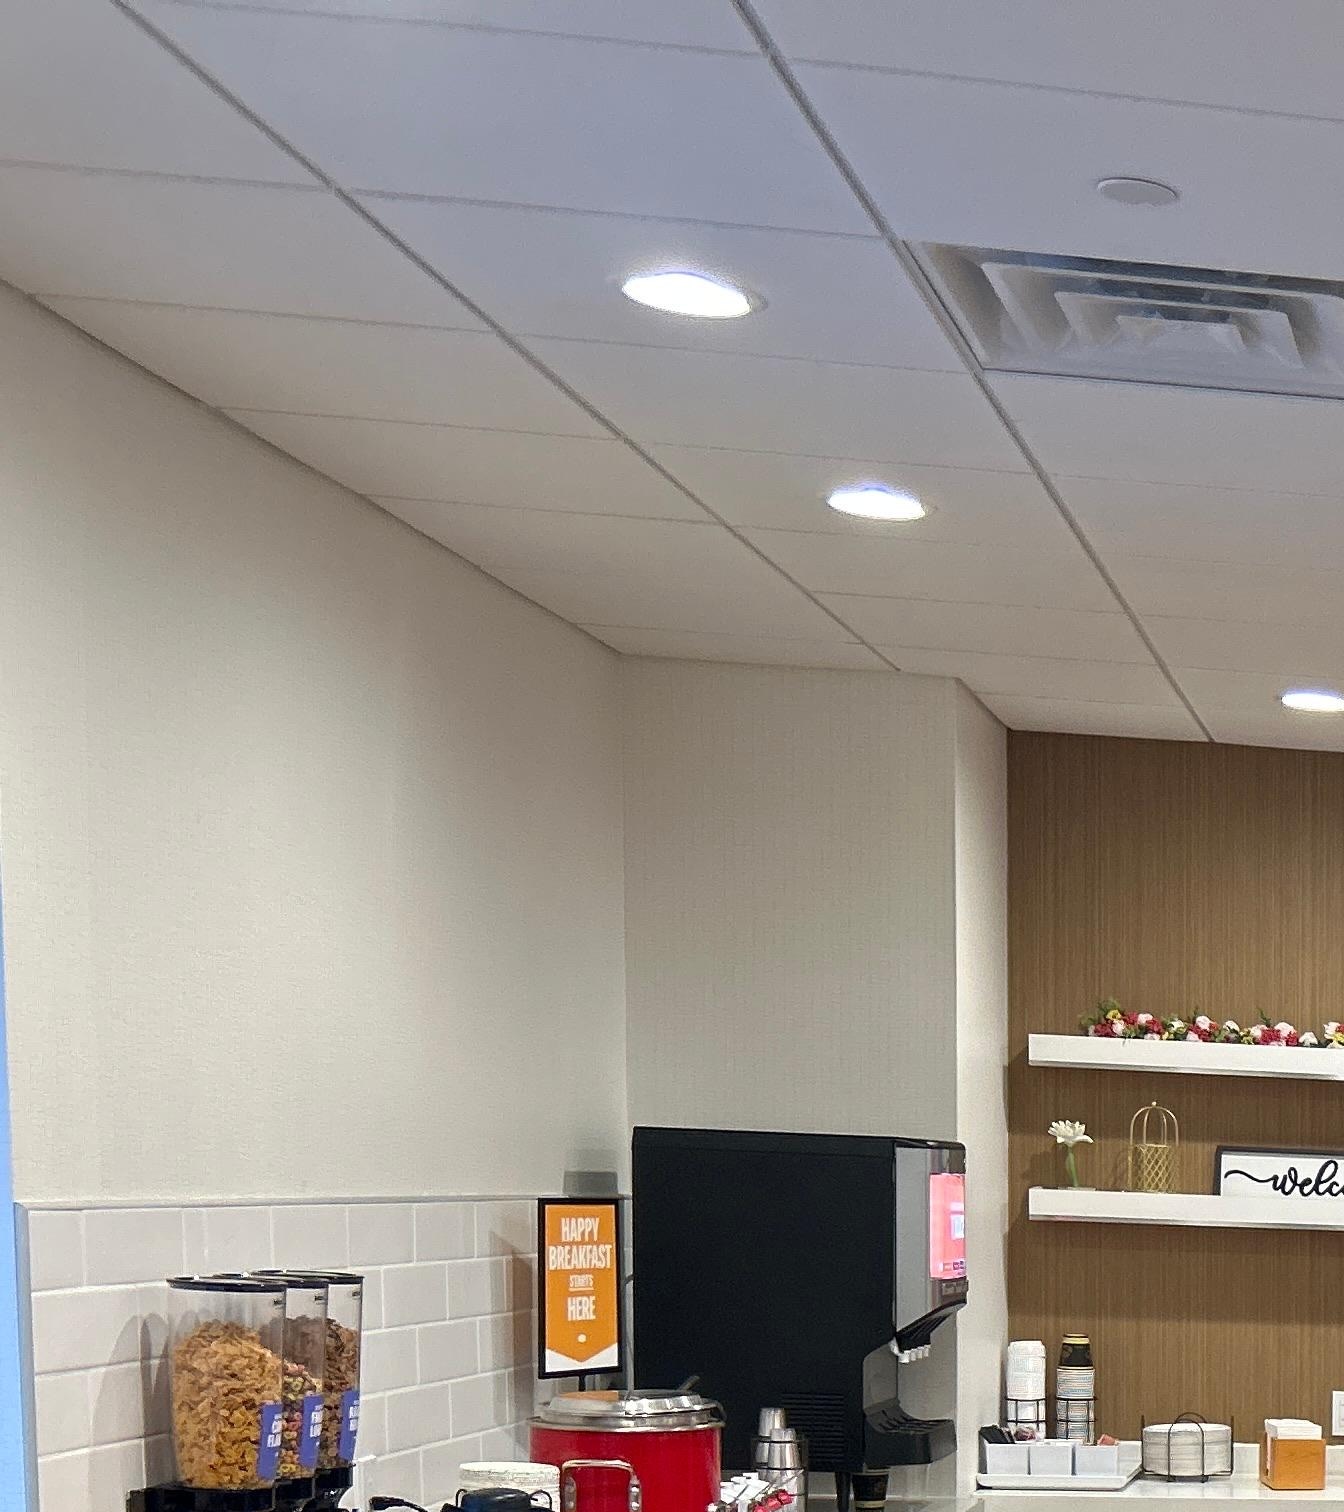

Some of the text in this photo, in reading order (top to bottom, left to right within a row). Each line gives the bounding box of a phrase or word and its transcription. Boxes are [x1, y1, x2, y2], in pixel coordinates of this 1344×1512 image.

[561, 1217, 600, 1242] HAPPY
[549, 1244, 613, 1270] BREAKFAST
[568, 1274, 595, 1288] STARTS
[567, 1296, 596, 1321] HERE
